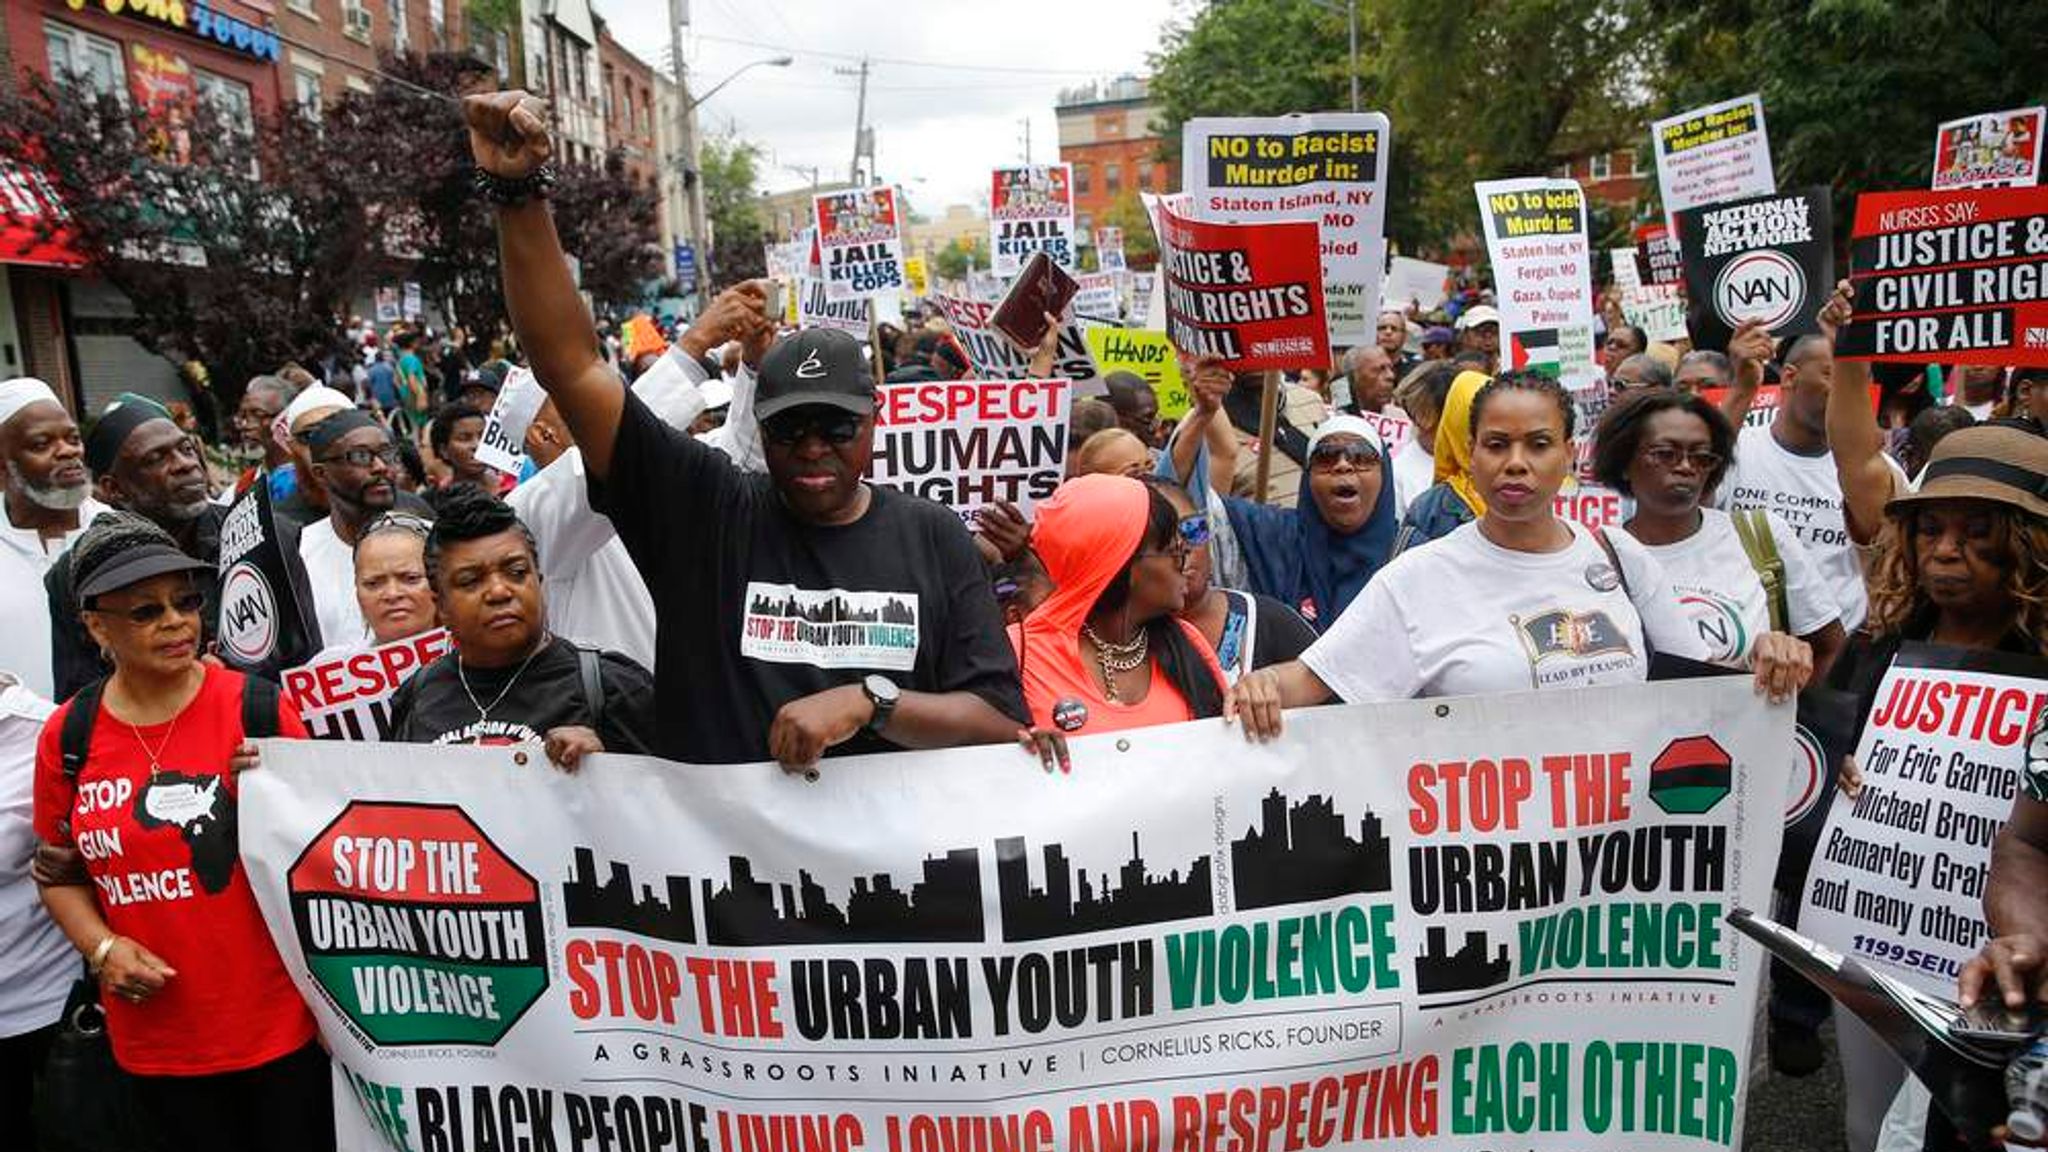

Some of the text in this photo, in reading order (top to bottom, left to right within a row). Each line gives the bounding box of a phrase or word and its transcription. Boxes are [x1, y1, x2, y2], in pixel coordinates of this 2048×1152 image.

[1211, 132, 1376, 159] NO to Racist
[1226, 159, 1359, 185] Murder in:
[1210, 190, 1374, 211] Staten Island, NY
[1491, 194, 1519, 214] NO
[1523, 192, 1542, 210] to
[1703, 197, 1809, 228] NATIONAL
[1879, 200, 1979, 231] NURSES SAY:
[999, 220, 1064, 239] JAIL
[1323, 213, 1355, 228] MO
[1706, 211, 1807, 242] ACTION
[830, 243, 893, 266] JAIL
[1704, 227, 1812, 257] NETWORK
[1875, 220, 2016, 271] JUSTICE
[830, 260, 899, 281] KILLER
[852, 277, 902, 292] COPS
[1229, 249, 1252, 285] &
[1202, 284, 1310, 324] RIGHTS
[1727, 274, 1790, 309] NAN
[1876, 262, 2048, 312] CIVIL RIG
[1103, 336, 1169, 363] HANDS
[1876, 315, 1940, 353] FOR
[1948, 311, 2009, 349] ALL
[866, 424, 1065, 479] HUMAN
[1733, 486, 1844, 512] ONE COMMU
[1812, 527, 1848, 547] FOR
[225, 589, 269, 636] NAN
[747, 616, 776, 639] STOP
[1864, 739, 2018, 801] For Eric Garne
[77, 777, 132, 815] STOP
[1408, 752, 1632, 835] STOP THE
[1850, 784, 2004, 850] Michael Brow
[77, 827, 124, 861] GUN
[1824, 828, 1925, 890] Ramarley
[332, 835, 483, 895] STOP THE
[1408, 825, 1727, 916] URBAN YOUTH
[1811, 877, 1849, 914] and
[1854, 887, 1913, 936] many
[307, 898, 418, 952] URBAN
[416, 908, 529, 961] YOUTH
[1518, 902, 1723, 977] VIOLENCE
[565, 938, 681, 1025] STOP
[687, 956, 784, 1040] THE
[791, 957, 972, 1042] URBAN
[981, 938, 1155, 1037] YOUTH
[1164, 903, 1400, 1012] VIOLENCE
[351, 965, 501, 1021] VIOLENCE
[1610, 991, 1717, 1006] INIATIVE
[593, 1019, 1384, 1083] A GRASSROOTS INIATIVE CORNELIUS RICKS, FOUNDER
[1068, 1098, 1162, 1152] AND
[1171, 1054, 1439, 1152] RESPECTING
[1451, 1041, 1571, 1136] EACH
[1582, 1040, 1738, 1147] OTHER
